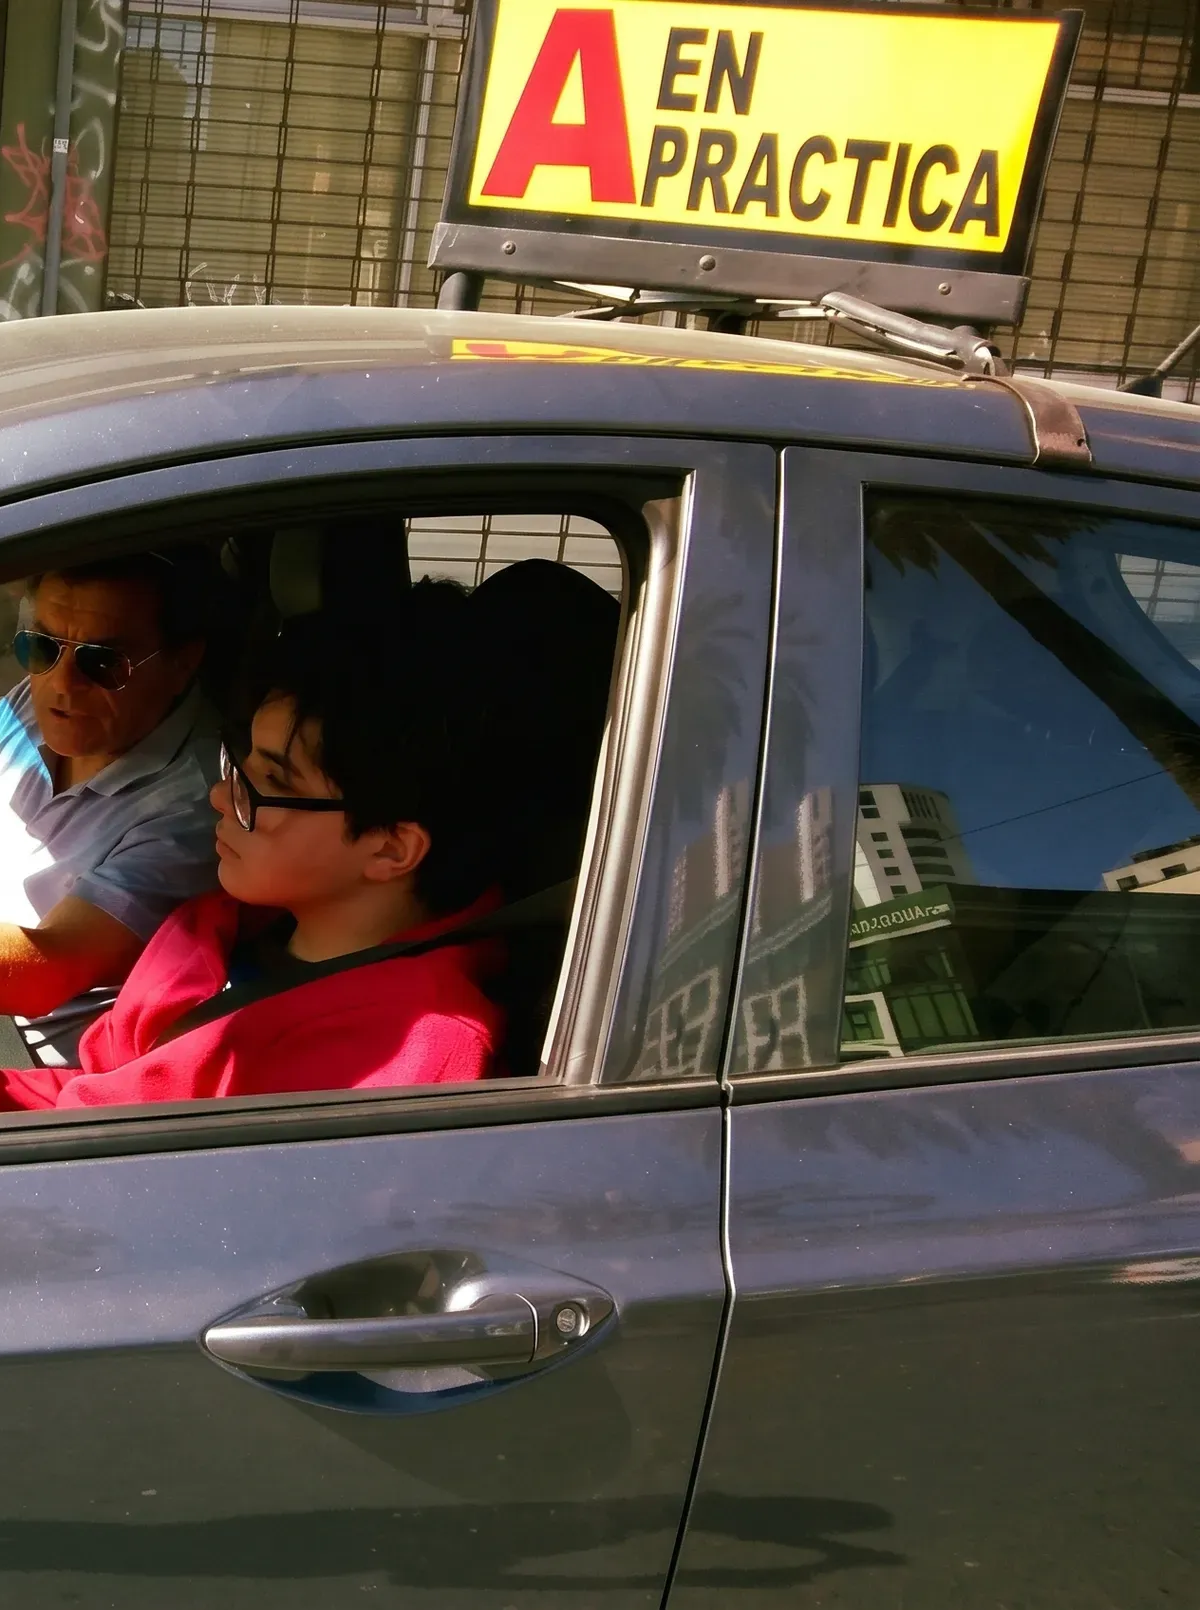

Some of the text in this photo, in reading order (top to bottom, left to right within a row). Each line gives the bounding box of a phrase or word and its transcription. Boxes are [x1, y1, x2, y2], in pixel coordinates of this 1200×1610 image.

[480, 8, 638, 205] A
[656, 26, 764, 116] EN
[640, 124, 1001, 238] PRACTICA
